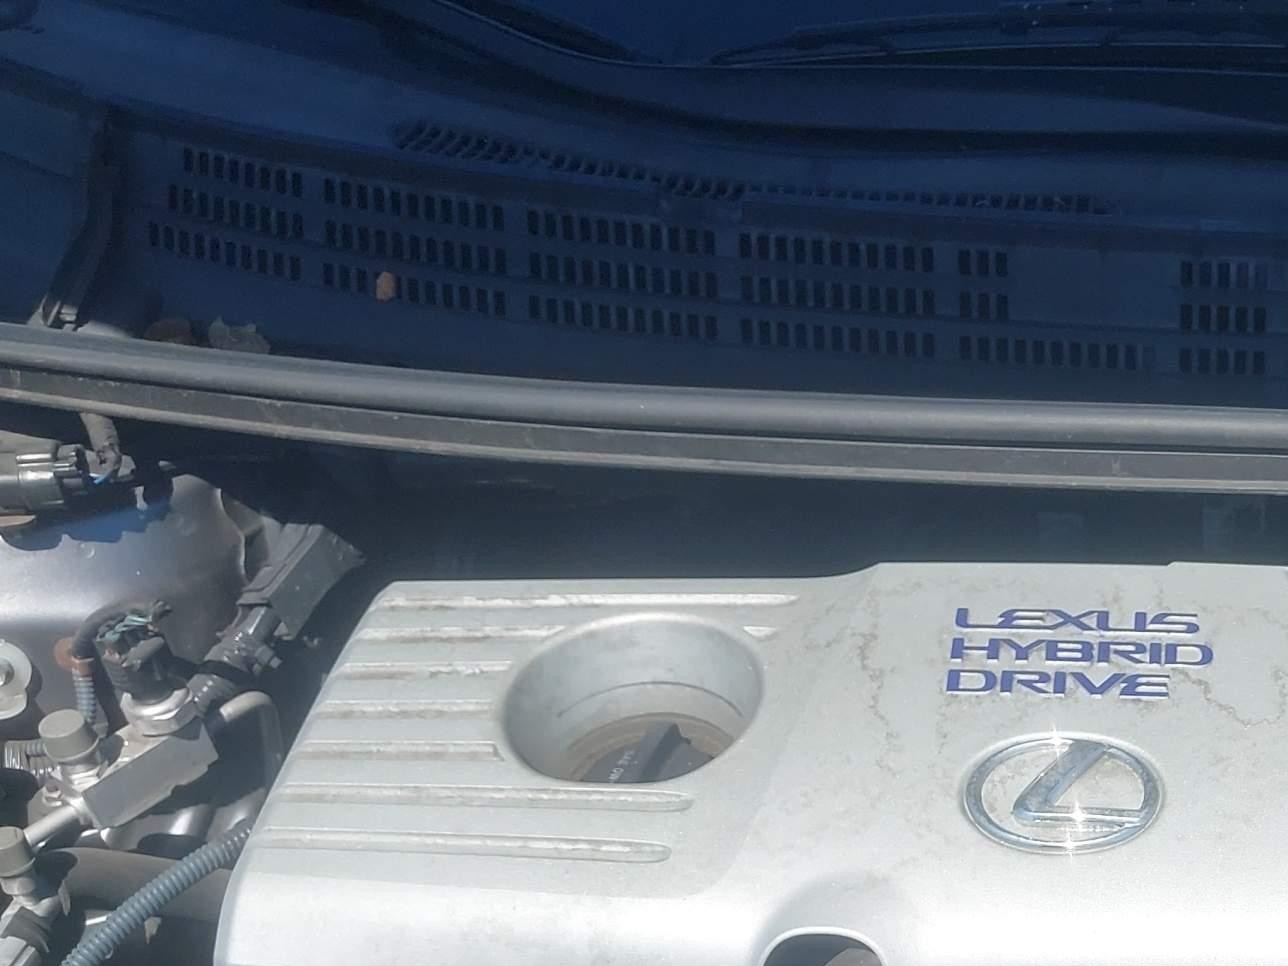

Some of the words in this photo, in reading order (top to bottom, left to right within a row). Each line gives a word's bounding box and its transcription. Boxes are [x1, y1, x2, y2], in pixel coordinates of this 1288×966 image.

[955, 607, 1200, 634] LEXUS
[949, 637, 1214, 667] HYBRID
[946, 669, 1170, 699] DRIVE
